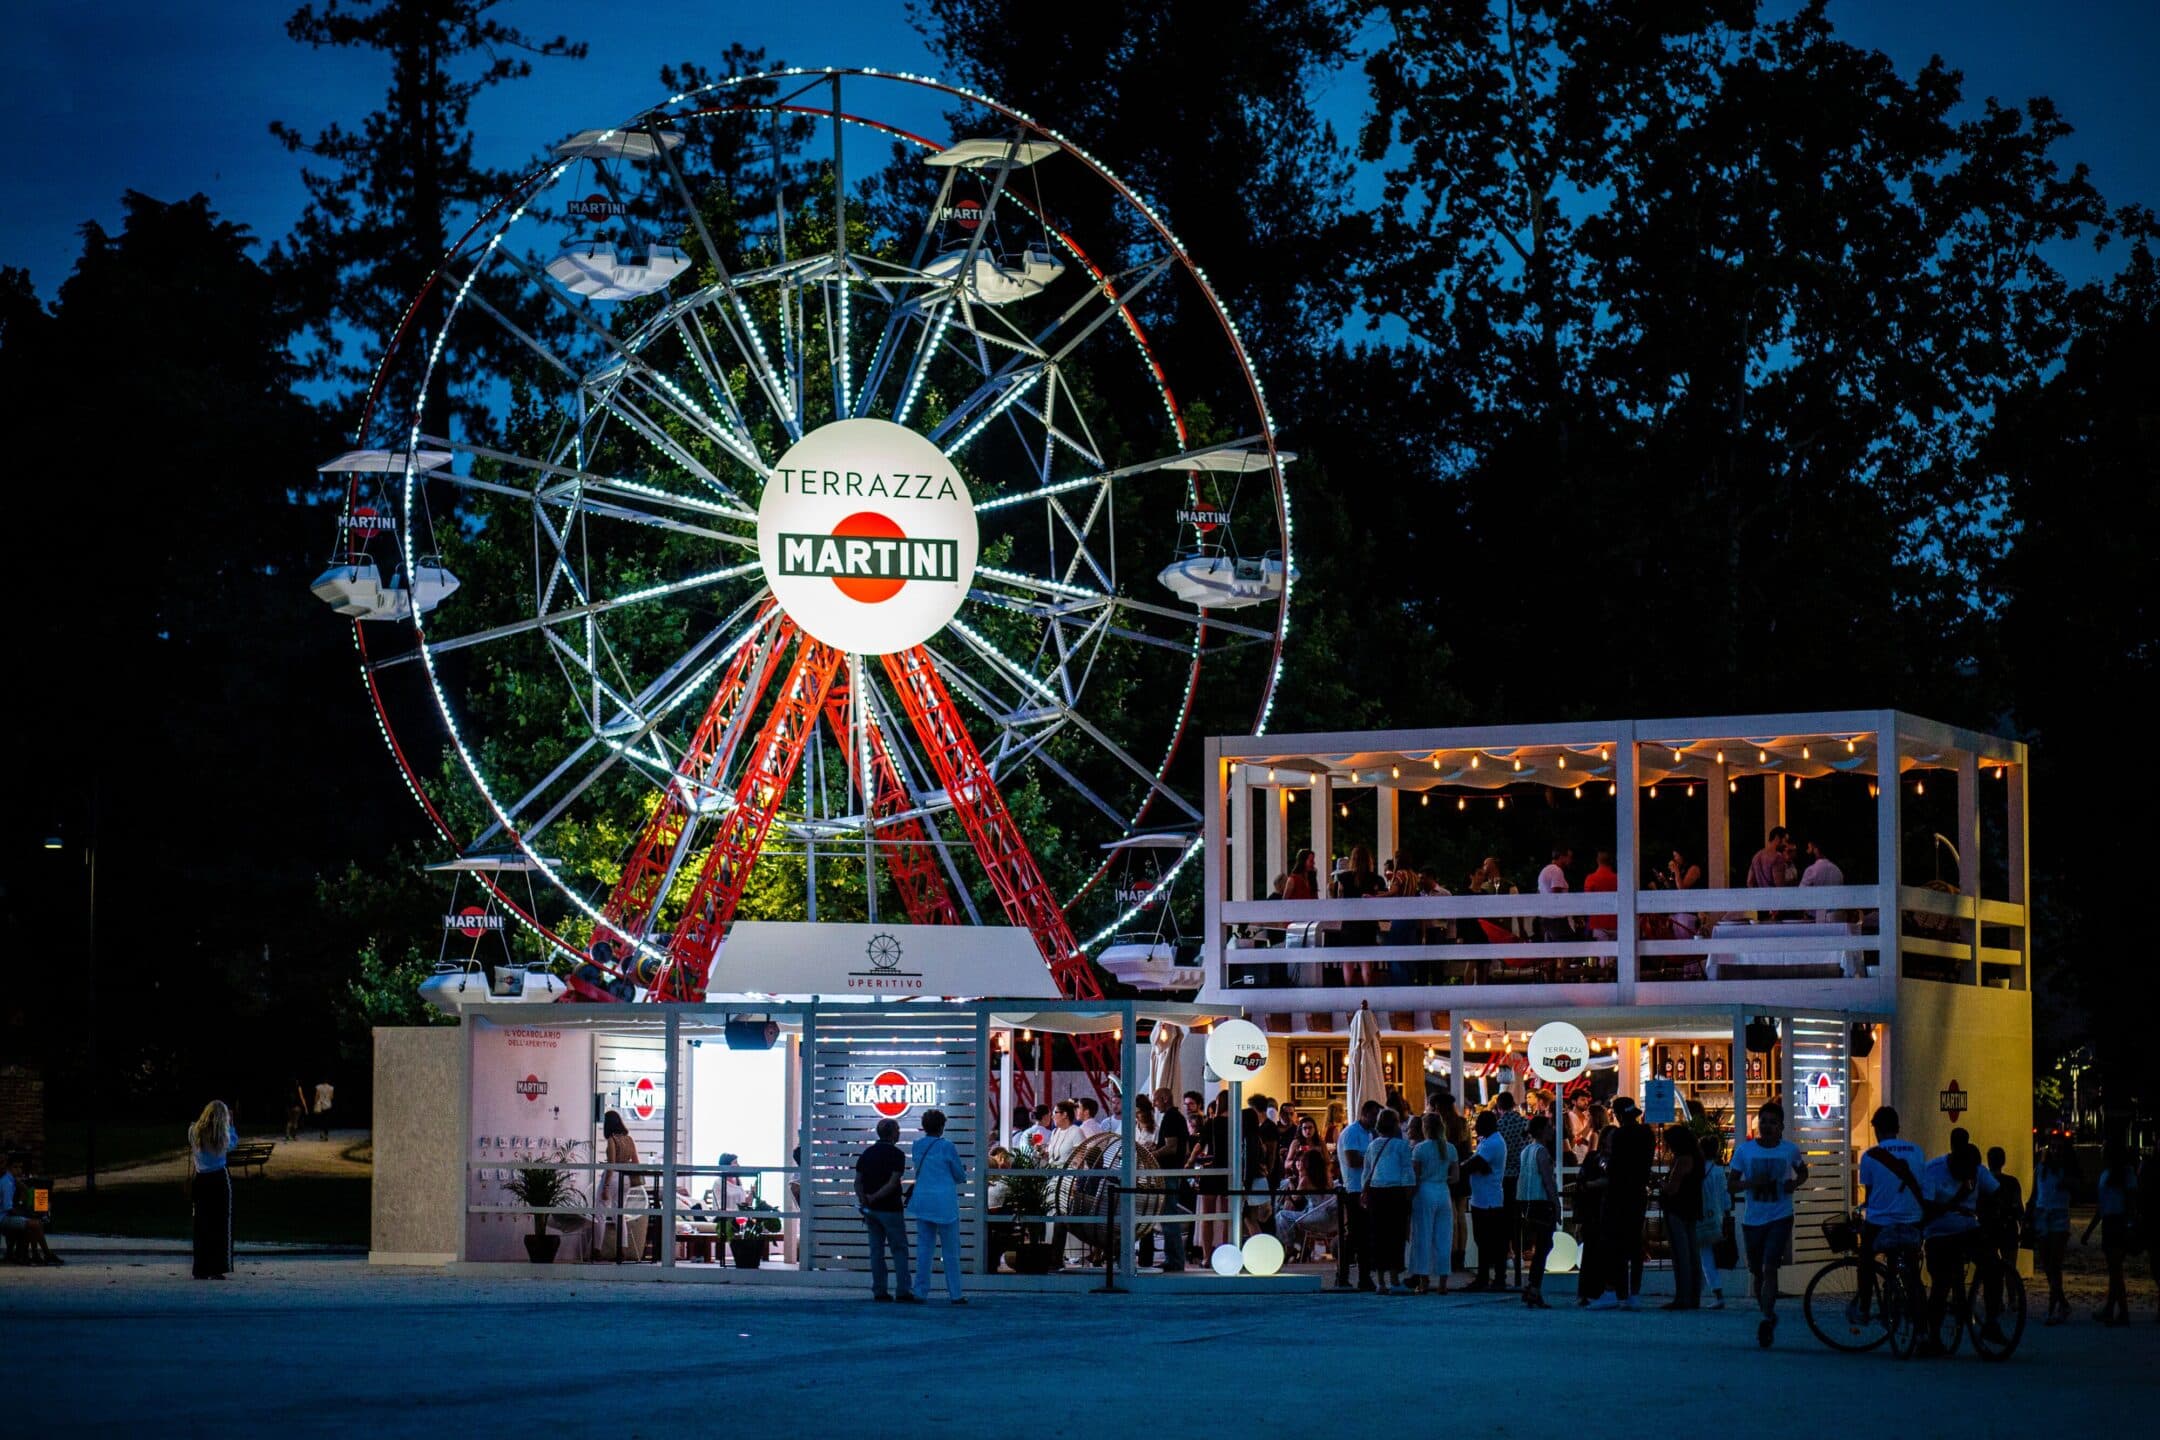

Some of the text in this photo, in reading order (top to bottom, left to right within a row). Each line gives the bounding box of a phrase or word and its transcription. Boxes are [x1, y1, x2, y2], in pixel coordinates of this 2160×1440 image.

[569, 201, 626, 214] MARTINI
[943, 207, 996, 221] MARTII
[778, 469, 958, 501] TERRAZZA
[338, 515, 397, 529] MARTINI
[1180, 510, 1231, 523] MARTINI
[784, 537, 952, 577] MARTINI
[445, 915, 503, 928] MARTINI
[848, 979, 923, 988] UPERITIVO
[517, 1082, 547, 1093] MARTINI
[850, 1084, 931, 1104] MARTINI
[1941, 1092, 1967, 1110] MARTINI
